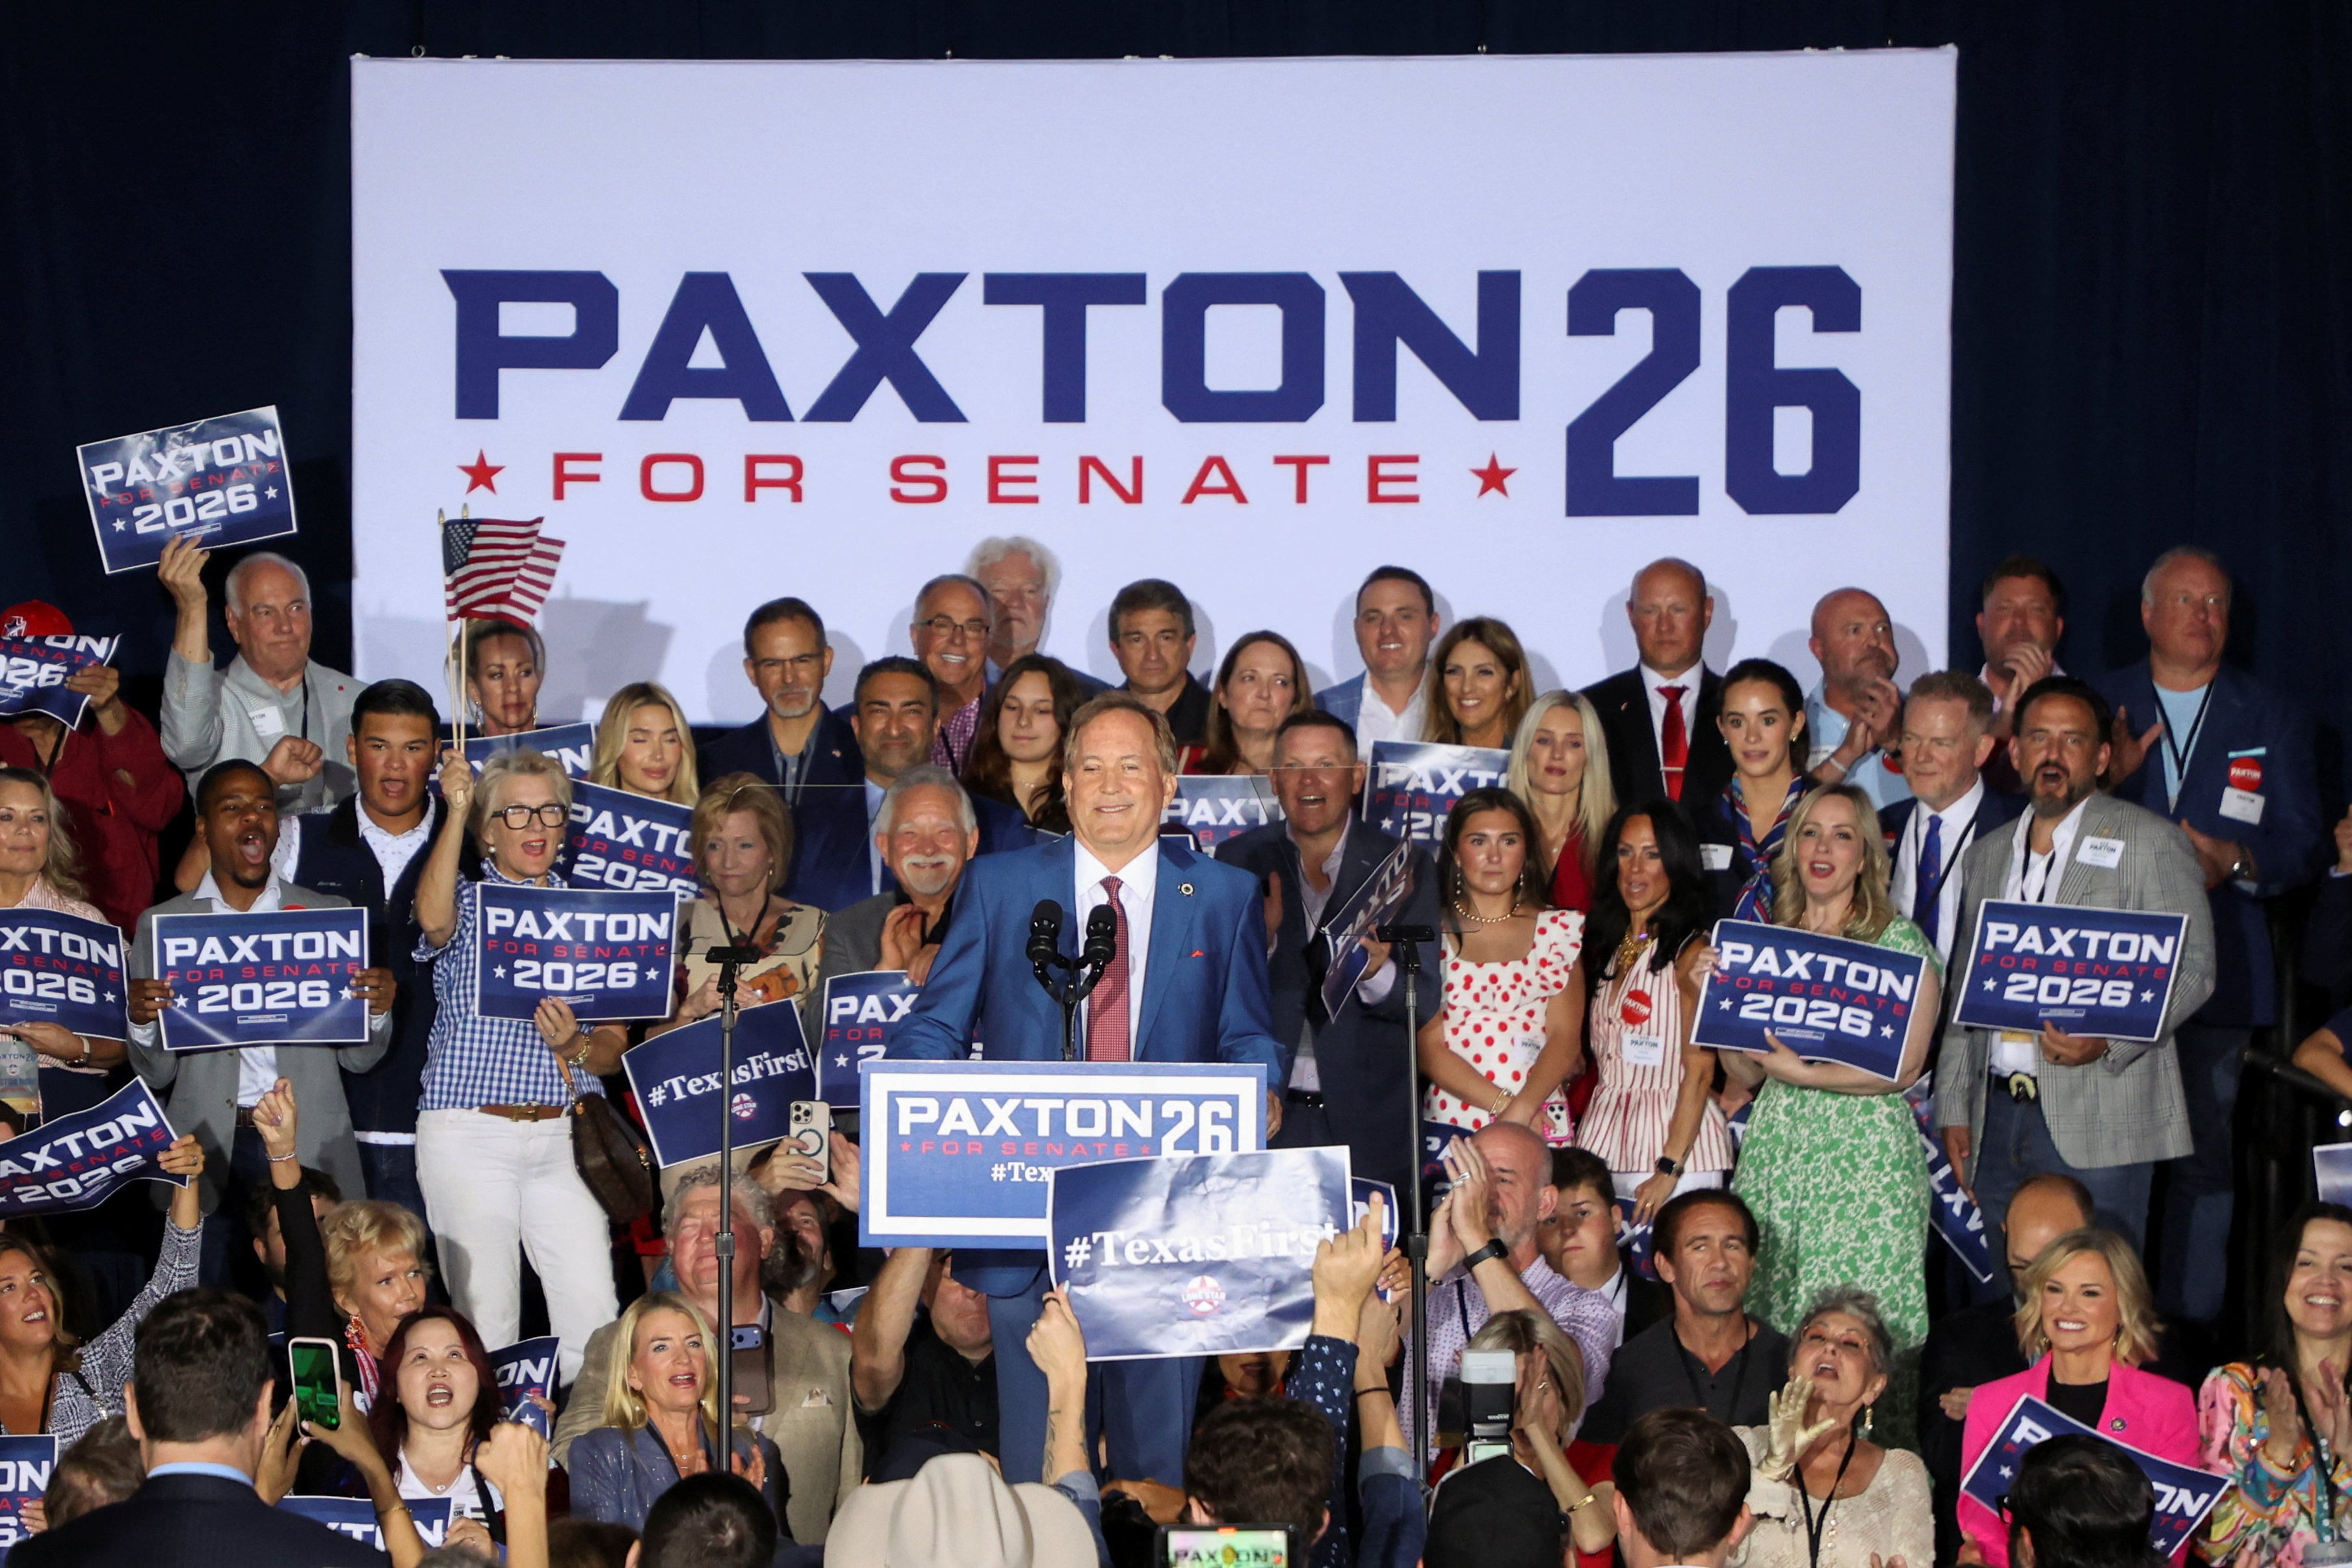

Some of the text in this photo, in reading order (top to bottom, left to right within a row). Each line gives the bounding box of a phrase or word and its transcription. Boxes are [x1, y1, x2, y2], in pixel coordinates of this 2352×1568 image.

[439, 265, 1862, 517] PAXTON 26
[90, 429, 279, 493] PAXTON
[552, 452, 1420, 504] FOR SENATE
[100, 461, 281, 508] FOR SENATE
[132, 482, 257, 534] 2026
[1375, 792, 1430, 808] FOR
[571, 835, 696, 875] OR SENA
[485, 906, 670, 942] PAXTON
[1984, 921, 2176, 964] PAXTON
[0, 926, 119, 969] XTON
[163, 930, 359, 967] PAXTON
[487, 939, 669, 959] FOR SENATE
[12, 954, 121, 982] SENATE
[166, 961, 361, 983] FOR SENATE
[513, 959, 638, 991] 2026
[1720, 941, 1914, 1002] PAXTON
[1980, 954, 2168, 980] FOR SENATE
[0, 968, 96, 1005] 026
[197, 980, 330, 1013] 2026
[1716, 974, 1908, 1017] FOR SENATE
[2003, 973, 2134, 1008] 2026
[830, 993, 919, 1025] PAX
[1738, 993, 1874, 1038] 2026
[828, 1027, 883, 1041] FOR
[1630, 1039, 1658, 1048] PAXTON
[0, 1099, 159, 1179] AXTON
[895, 1097, 1233, 1156] PAXTON 26
[0, 1127, 166, 1190] OR SENATE
[921, 1140, 1129, 1156] FOR SENATE
[1181, 1290, 1227, 1302] LONE STAR
[1174, 1548, 1268, 1563] PAXON
